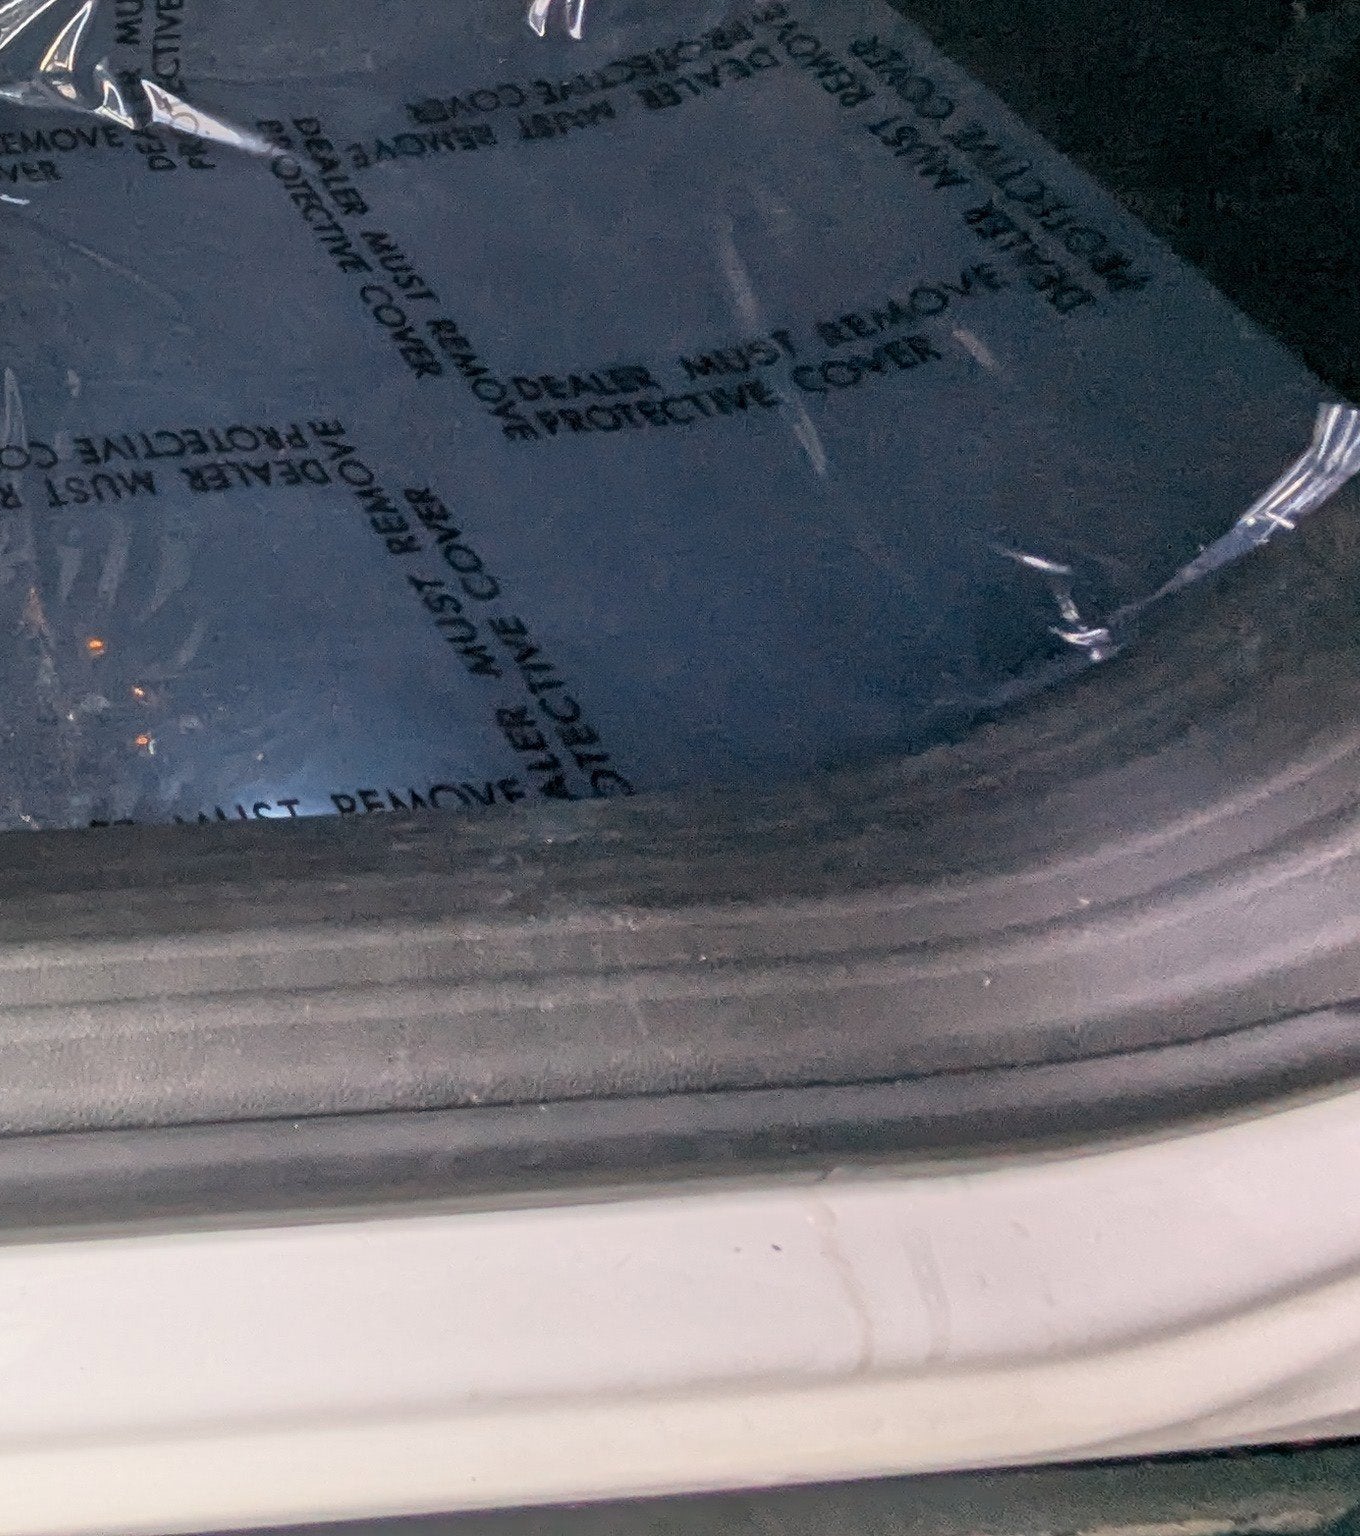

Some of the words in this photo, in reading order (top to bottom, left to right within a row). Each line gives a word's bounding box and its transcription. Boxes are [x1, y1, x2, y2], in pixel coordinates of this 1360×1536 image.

[346, 122, 498, 171] REMOVE
[255, 117, 374, 275] PROTECTIVE
[358, 283, 442, 380] COVER
[291, 115, 370, 218] DEALER
[360, 229, 441, 305] MUST
[426, 316, 540, 442] REMOVE
[513, 363, 664, 403] DEALER
[679, 329, 799, 383] MUST
[813, 262, 1008, 348] REMOVE
[534, 376, 781, 437] PROTECTIVE
[792, 334, 943, 394] COVER
[48, 469, 158, 510] MUST
[73, 423, 308, 466] PROTECTIVE
[179, 459, 333, 495] DEALER
[309, 419, 421, 556] REMOVE
[402, 486, 502, 601] COVER
[406, 573, 503, 679] MUST
